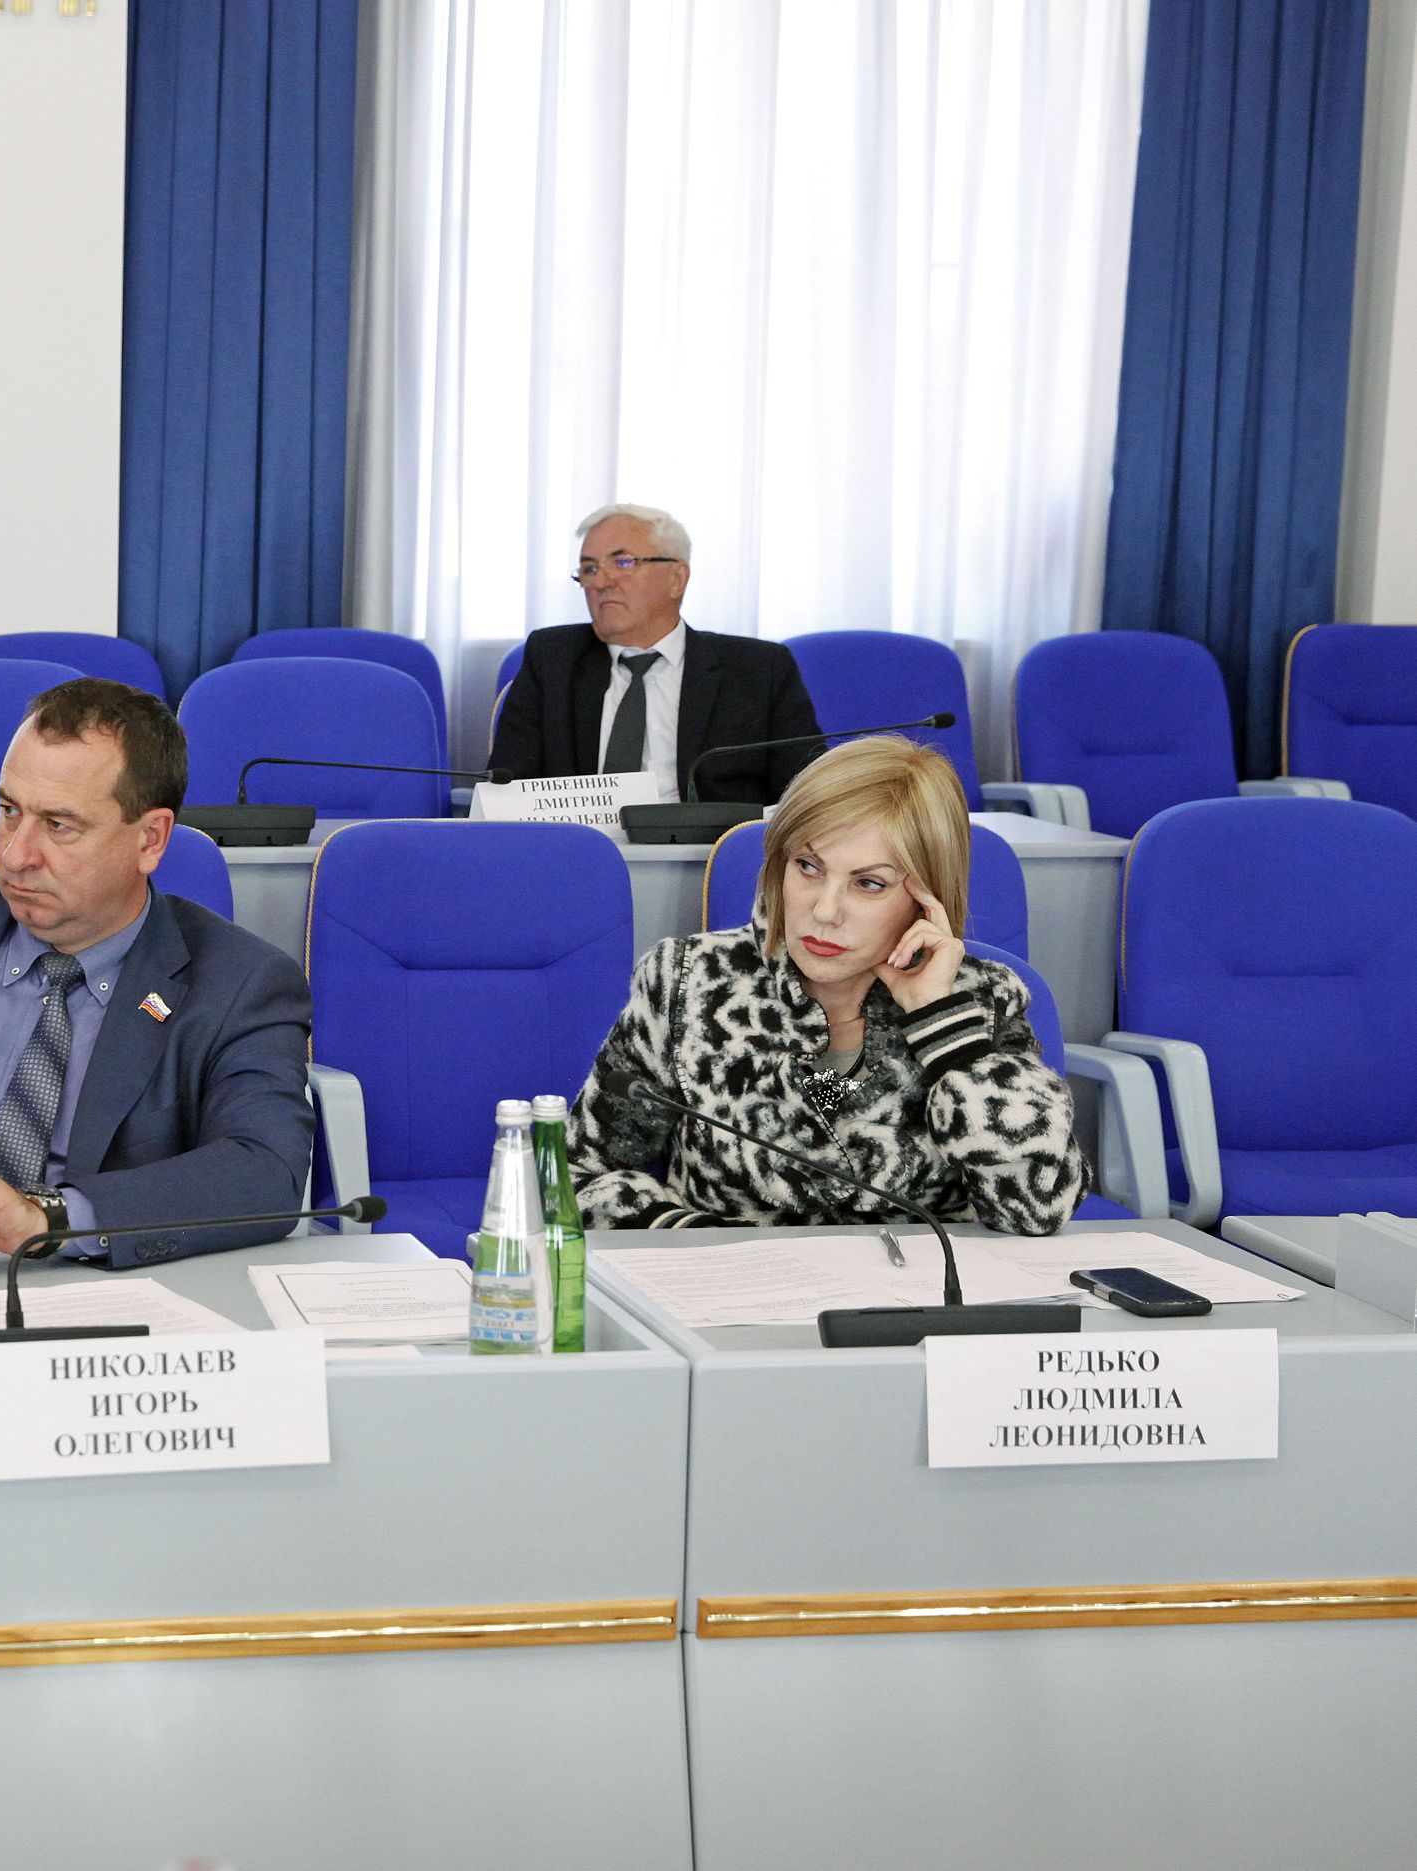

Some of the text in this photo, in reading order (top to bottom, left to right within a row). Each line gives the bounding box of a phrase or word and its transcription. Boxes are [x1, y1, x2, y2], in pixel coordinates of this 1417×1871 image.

[521, 776, 619, 792] ГРИБЕННИК
[533, 792, 613, 811] ДМИТРИЙ
[50, 1350, 237, 1381] НИКОЛАЕВ
[1037, 1350, 1160, 1376] РЕДЬКО
[91, 1391, 199, 1417] ИГОРЬ
[1013, 1387, 1184, 1414] ЛЮДМИЛА
[54, 1426, 236, 1458] ОЛЕГОВИЧ
[989, 1424, 1208, 1451] ЛЕОНИДОВНА
